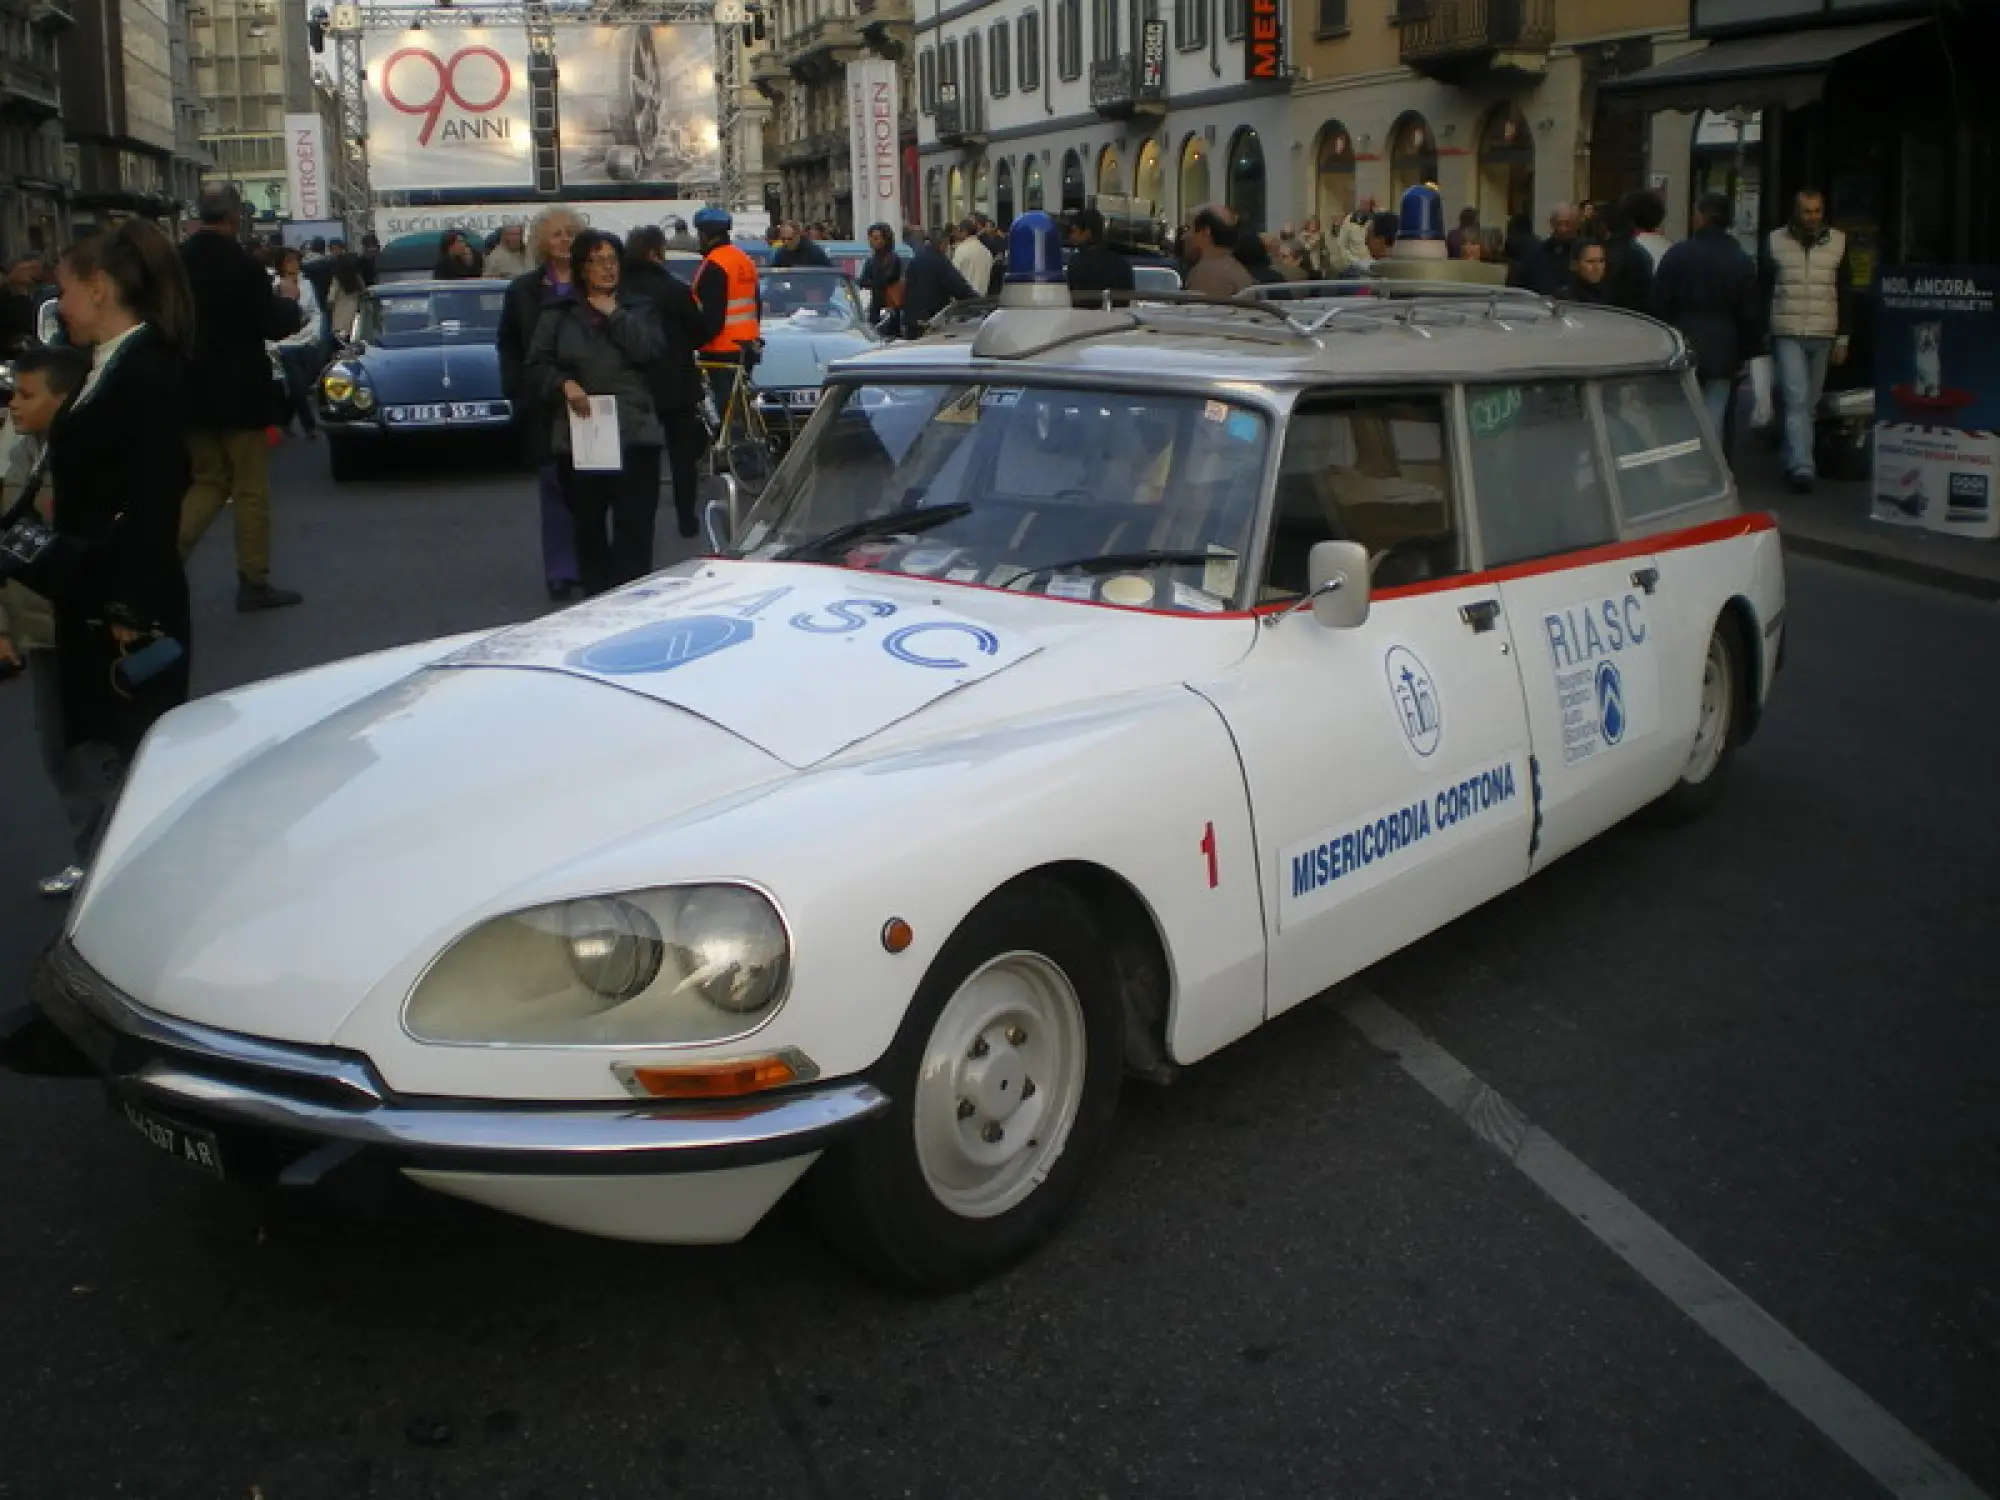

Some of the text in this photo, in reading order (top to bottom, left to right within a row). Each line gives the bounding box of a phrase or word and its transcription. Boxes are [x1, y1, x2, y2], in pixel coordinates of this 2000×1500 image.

[380, 47, 511, 148] 90
[441, 116, 511, 141] ANNI
[1201, 820, 1219, 889] 1
[1292, 761, 1516, 898] MISERICORDIA CORTONA
